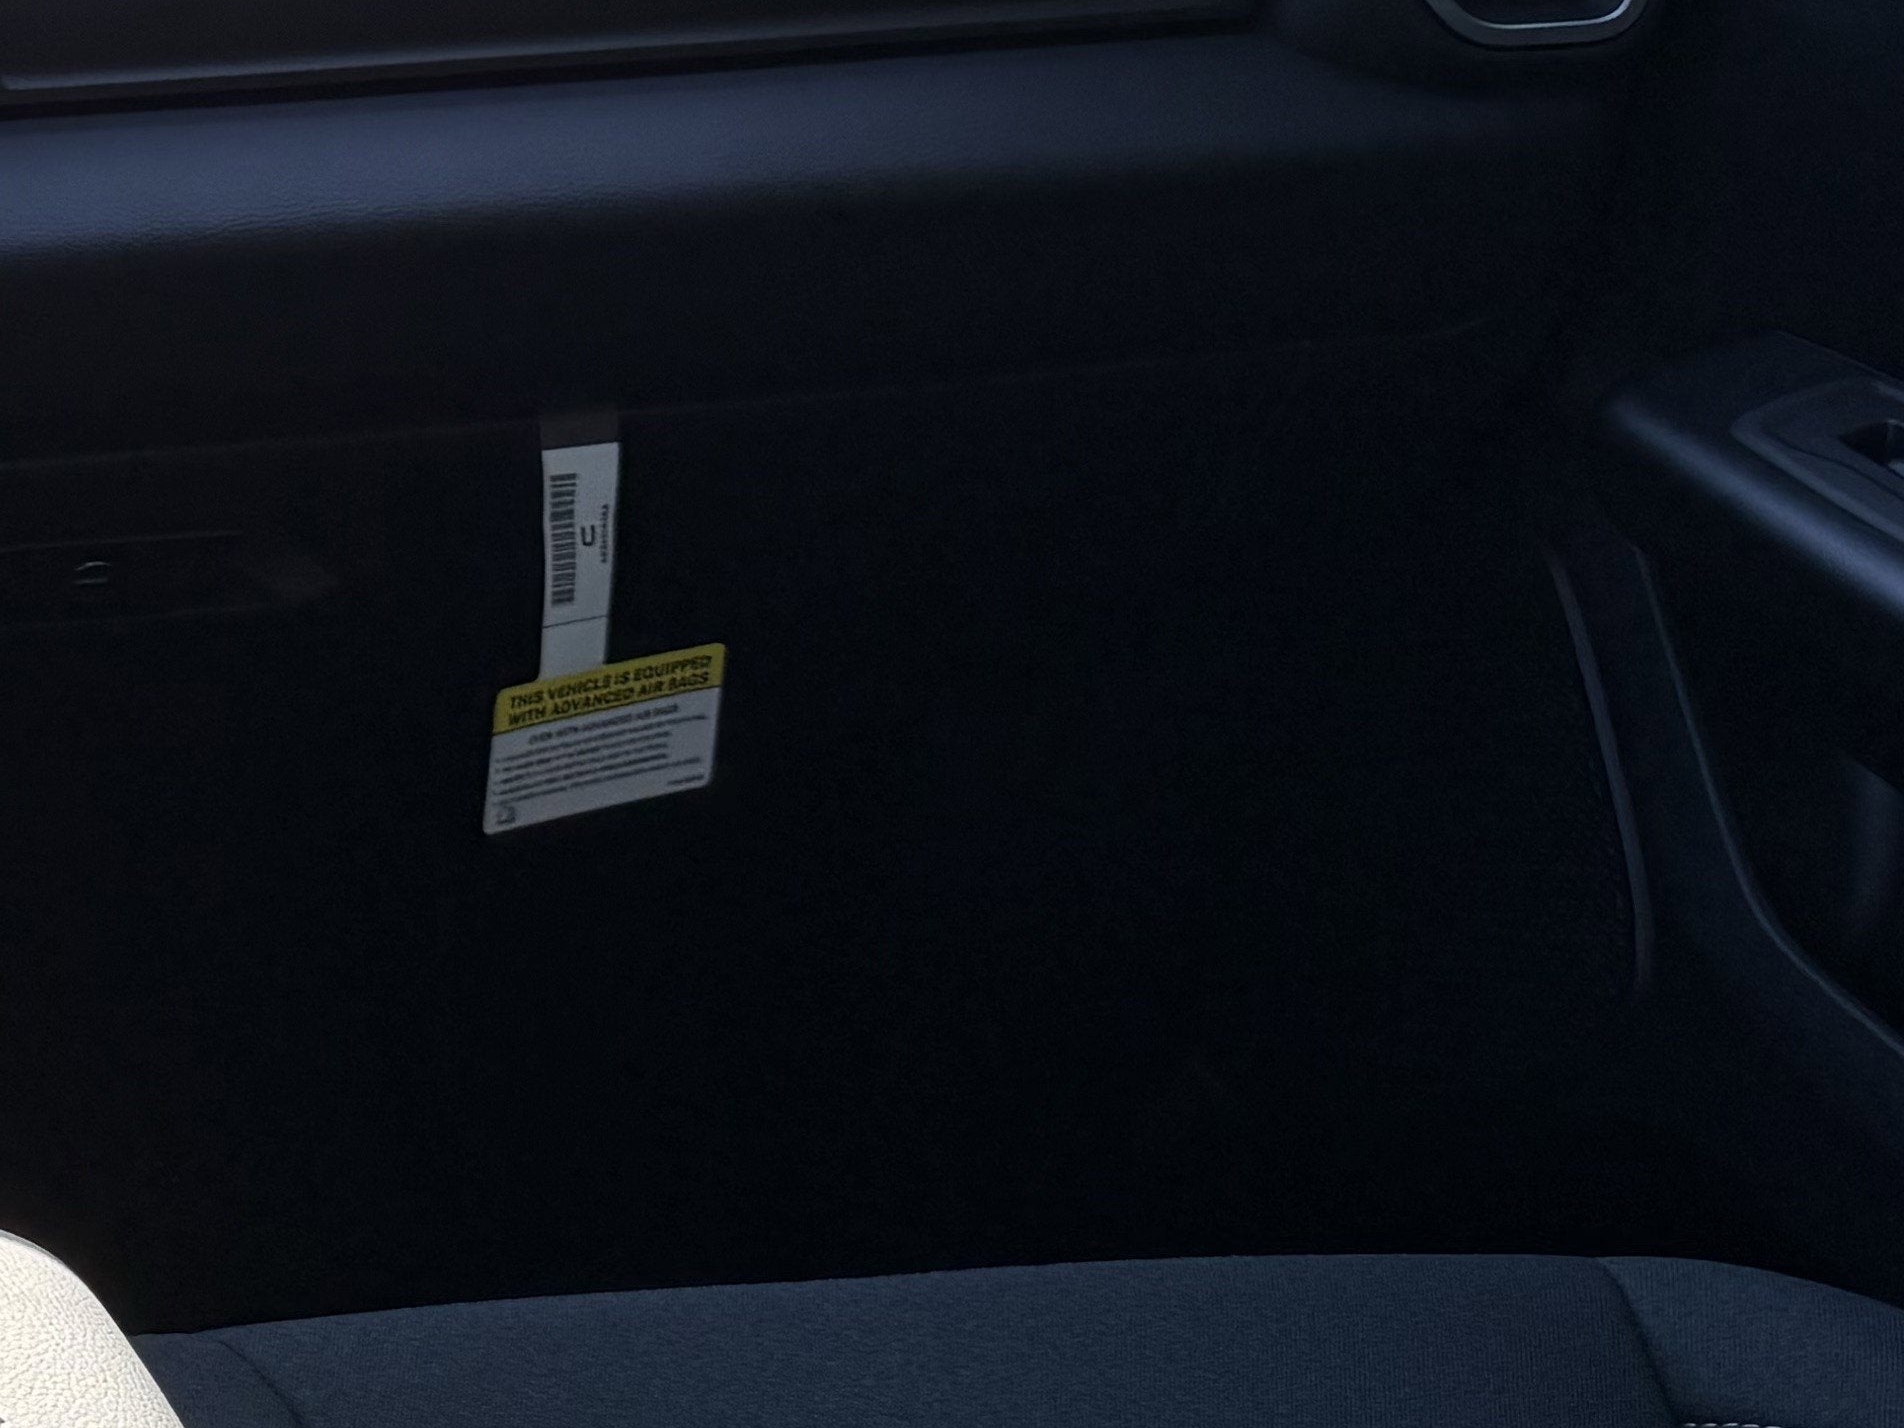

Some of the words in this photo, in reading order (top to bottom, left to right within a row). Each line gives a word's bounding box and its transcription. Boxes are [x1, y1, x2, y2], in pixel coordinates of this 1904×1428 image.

[508, 707, 543, 726] WITH
[551, 687, 634, 719] ADVANCED
[639, 679, 665, 696] AIR
[668, 672, 709, 691] BAGS
[511, 690, 544, 709] THIS
[547, 674, 612, 700] VEHICLE
[614, 671, 630, 686] IS
[633, 655, 713, 682] EQUIPPED
